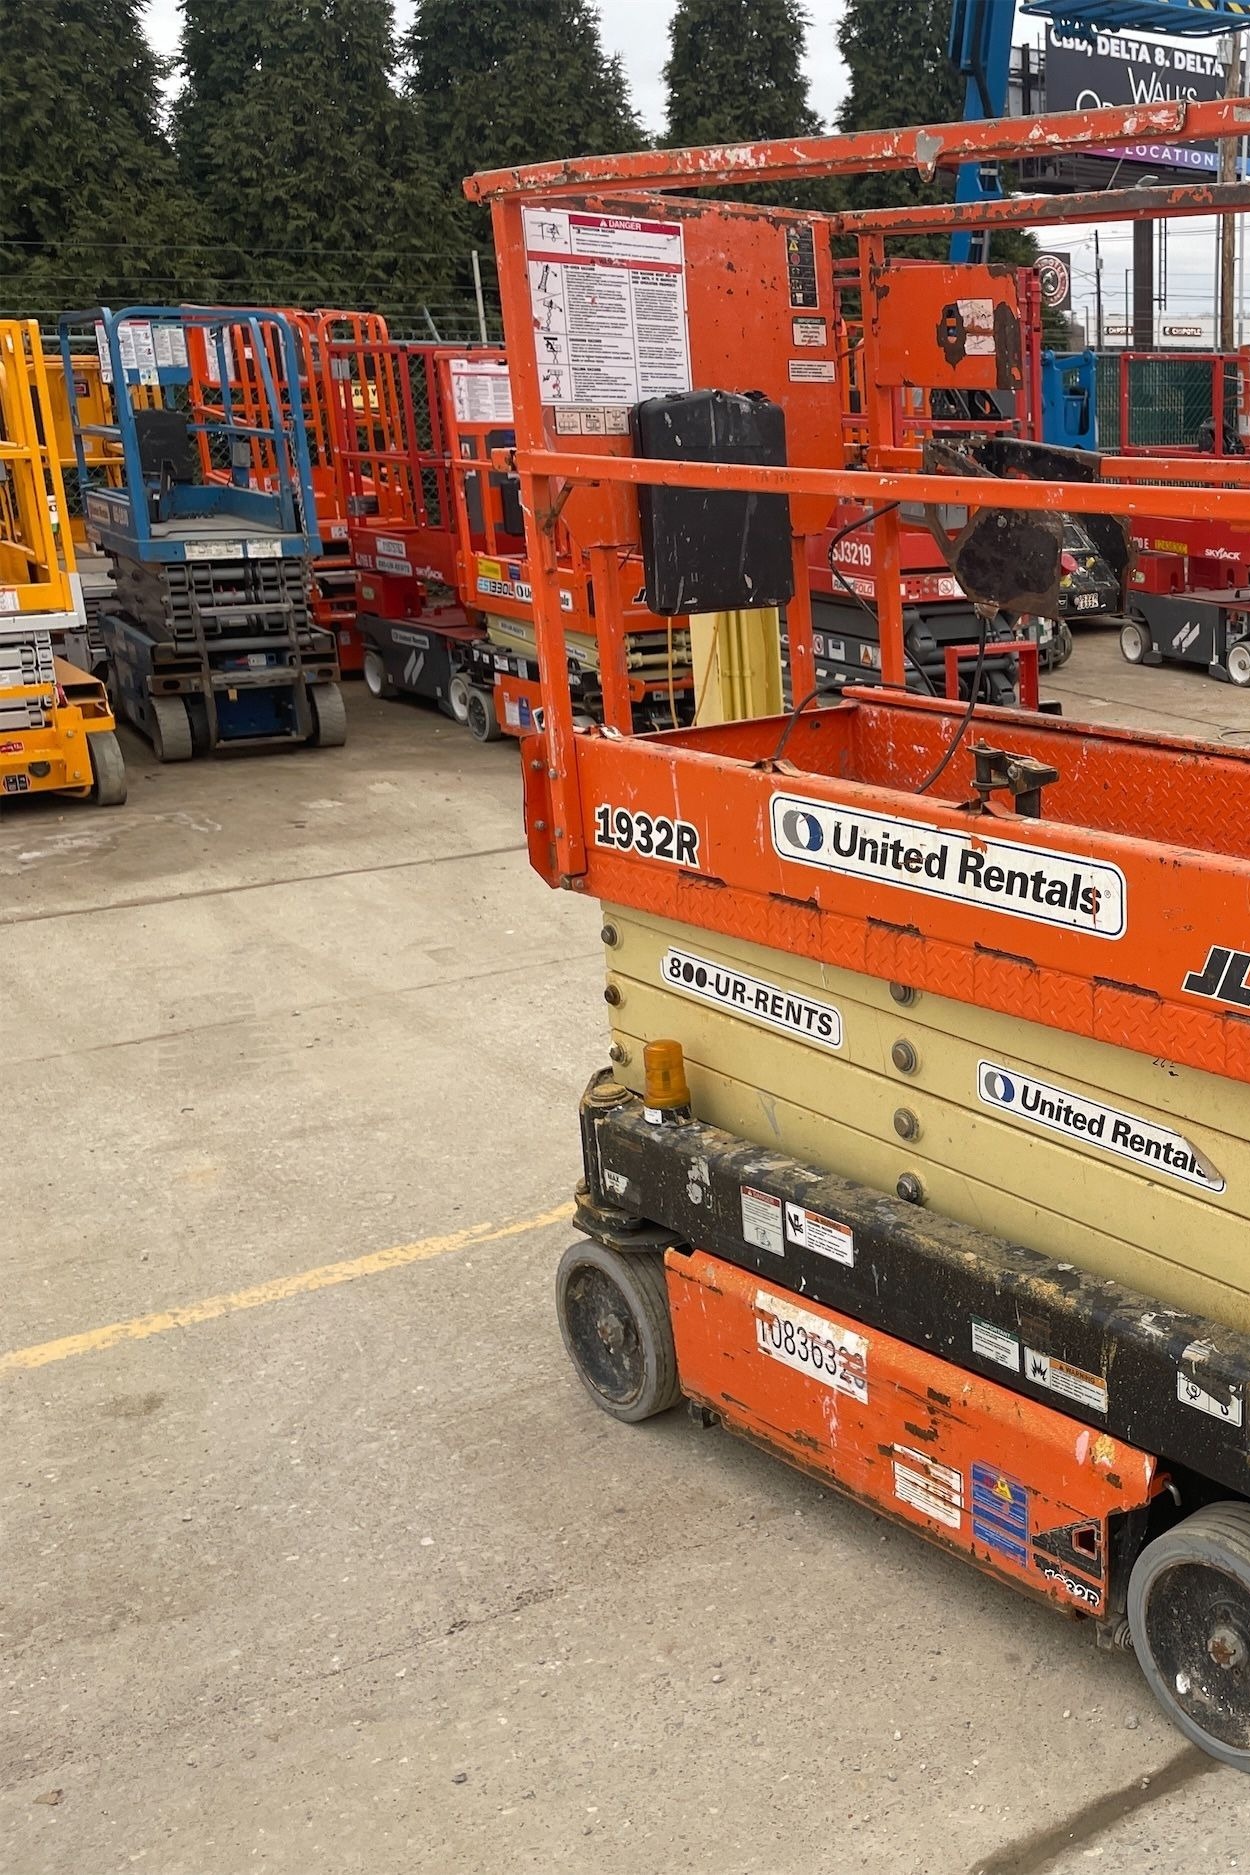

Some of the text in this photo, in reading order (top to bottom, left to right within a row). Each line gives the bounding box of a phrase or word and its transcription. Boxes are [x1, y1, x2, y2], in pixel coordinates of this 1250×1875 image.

[1096, 35, 1151, 66] DELTA
[1174, 56, 1225, 79] DELTA
[1125, 145, 1224, 167] LOCATION
[608, 219, 642, 232] DANGER
[1204, 547, 1241, 561] SKYJACK
[593, 803, 700, 867] 1932R
[832, 820, 1103, 917] United Rentals
[668, 954, 833, 1037] 800-UR-RENTS
[1020, 1084, 1105, 1138] United
[1064, 1367, 1096, 1385] WARNING
